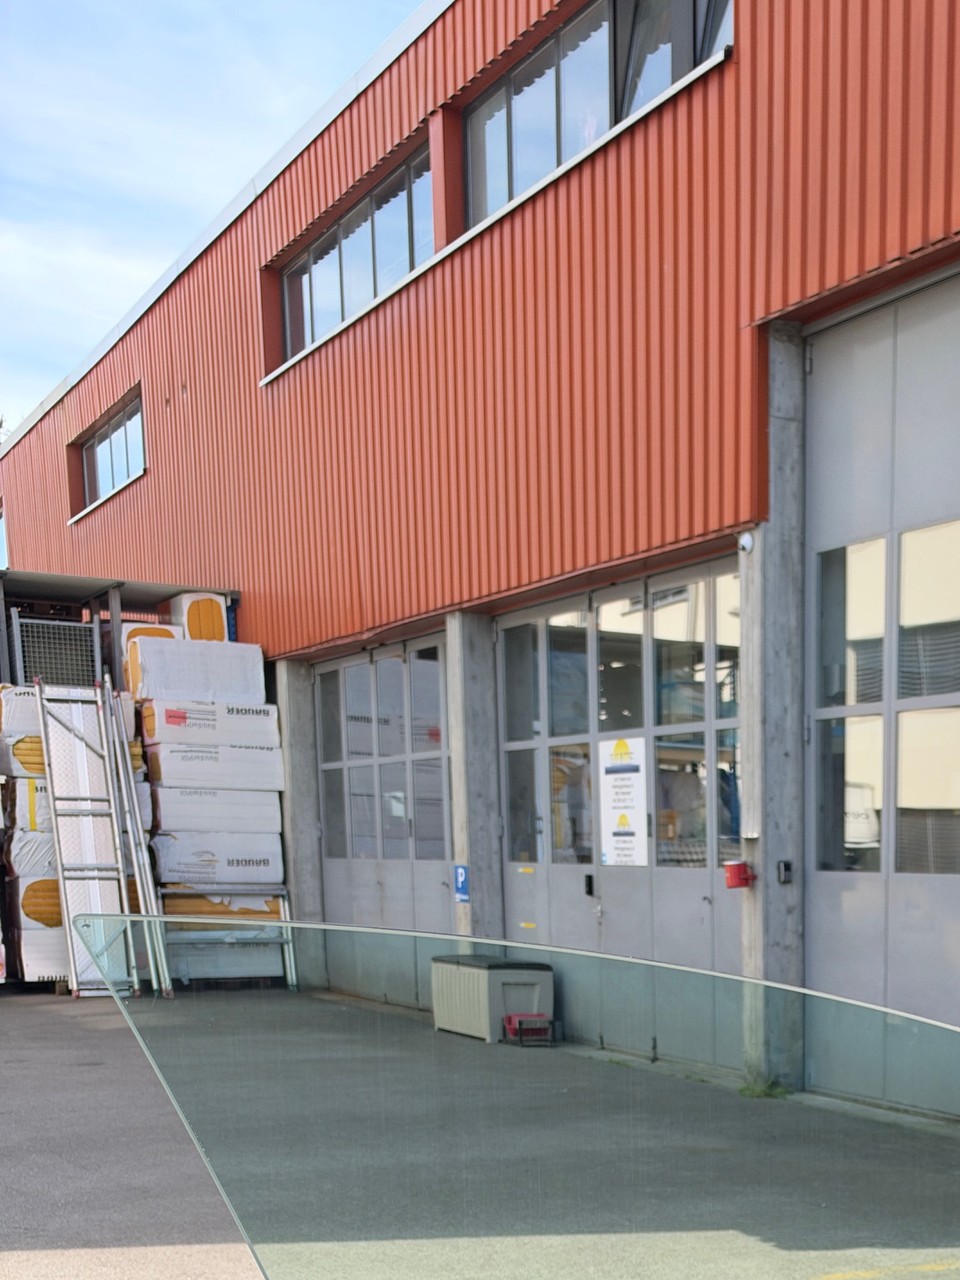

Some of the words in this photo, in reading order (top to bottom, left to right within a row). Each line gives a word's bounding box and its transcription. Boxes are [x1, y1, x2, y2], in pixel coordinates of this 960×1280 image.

[227, 706, 270, 716] BAUDER
[227, 858, 270, 868] BAUDER
[457, 867, 466, 888] P
